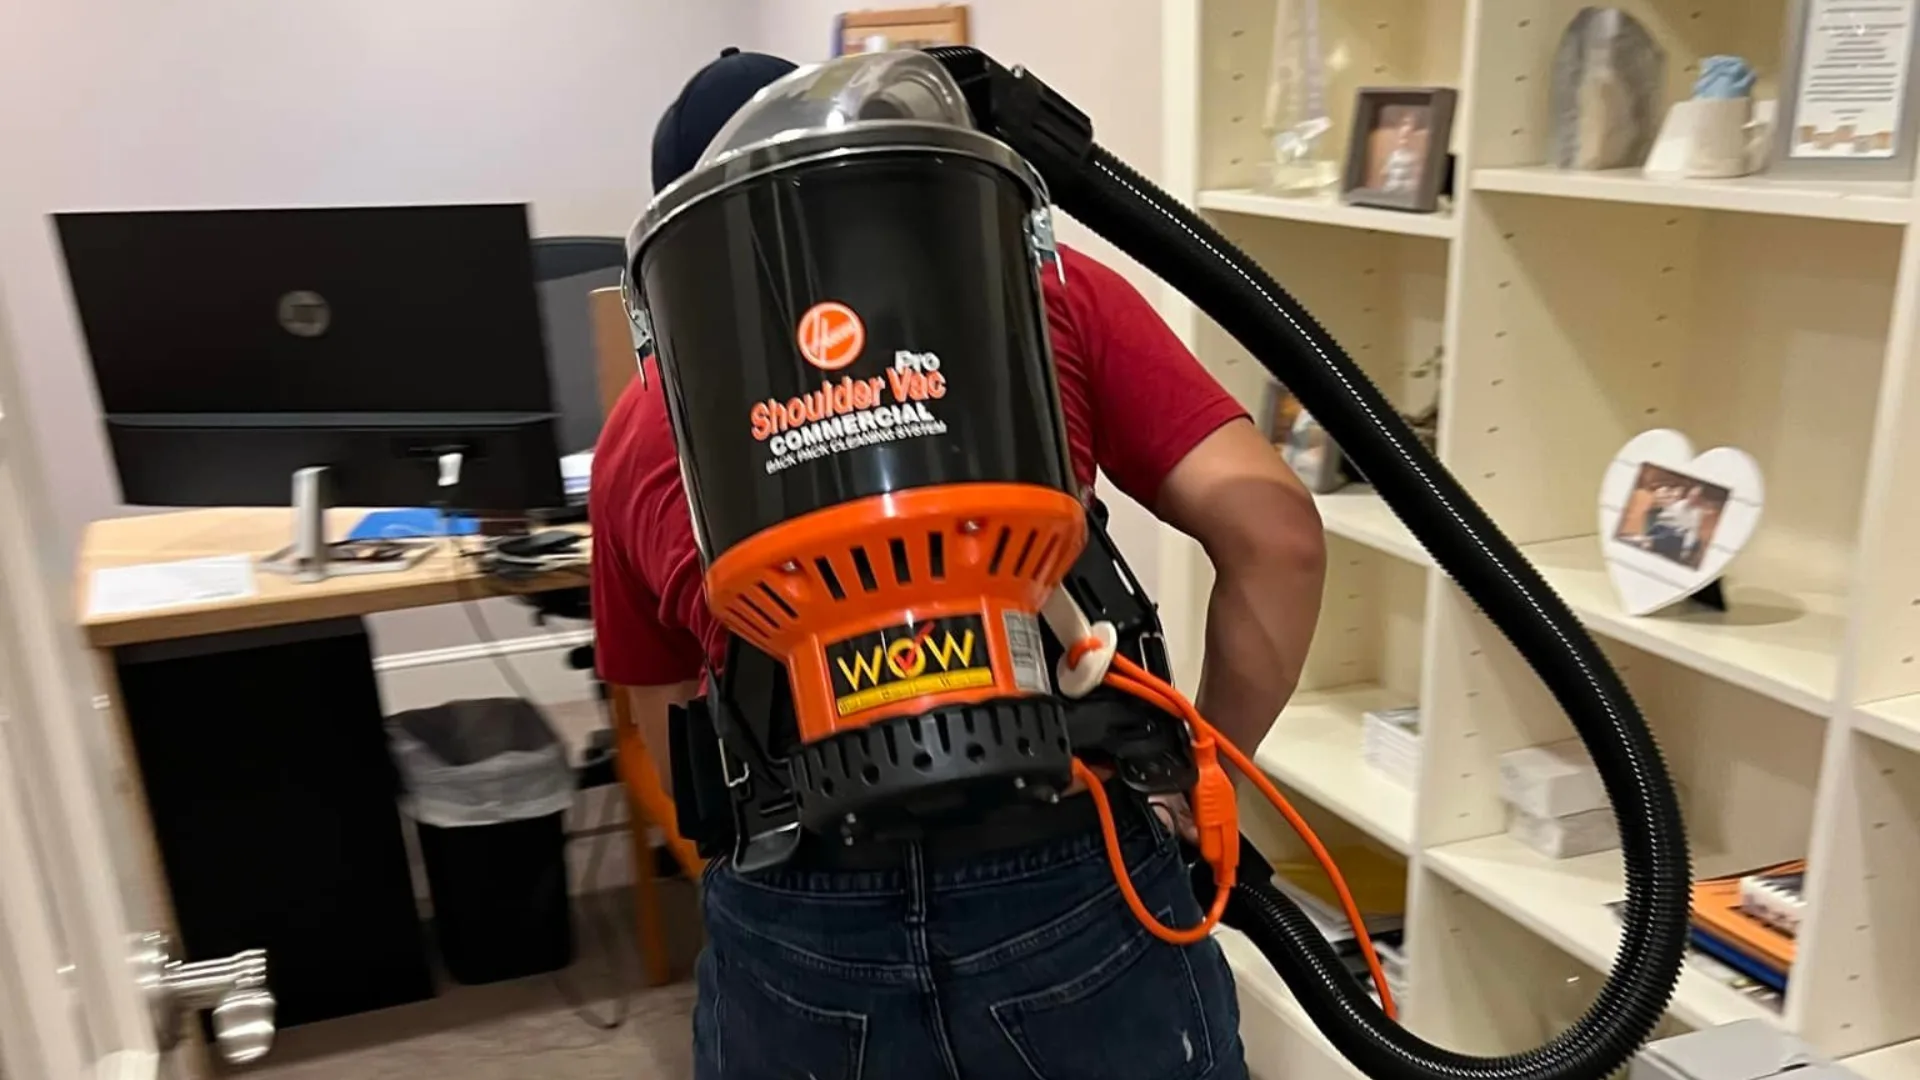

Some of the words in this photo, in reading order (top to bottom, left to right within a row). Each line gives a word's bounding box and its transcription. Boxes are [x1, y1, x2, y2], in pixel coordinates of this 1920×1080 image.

[895, 350, 940, 374] Pro
[751, 375, 885, 441] Shoulder
[885, 366, 947, 402] Vac
[769, 402, 935, 456] COMMERCIAL
[829, 427, 895, 454] CLEANING
[894, 419, 948, 440] SYSTEM
[836, 628, 975, 691] WOW
